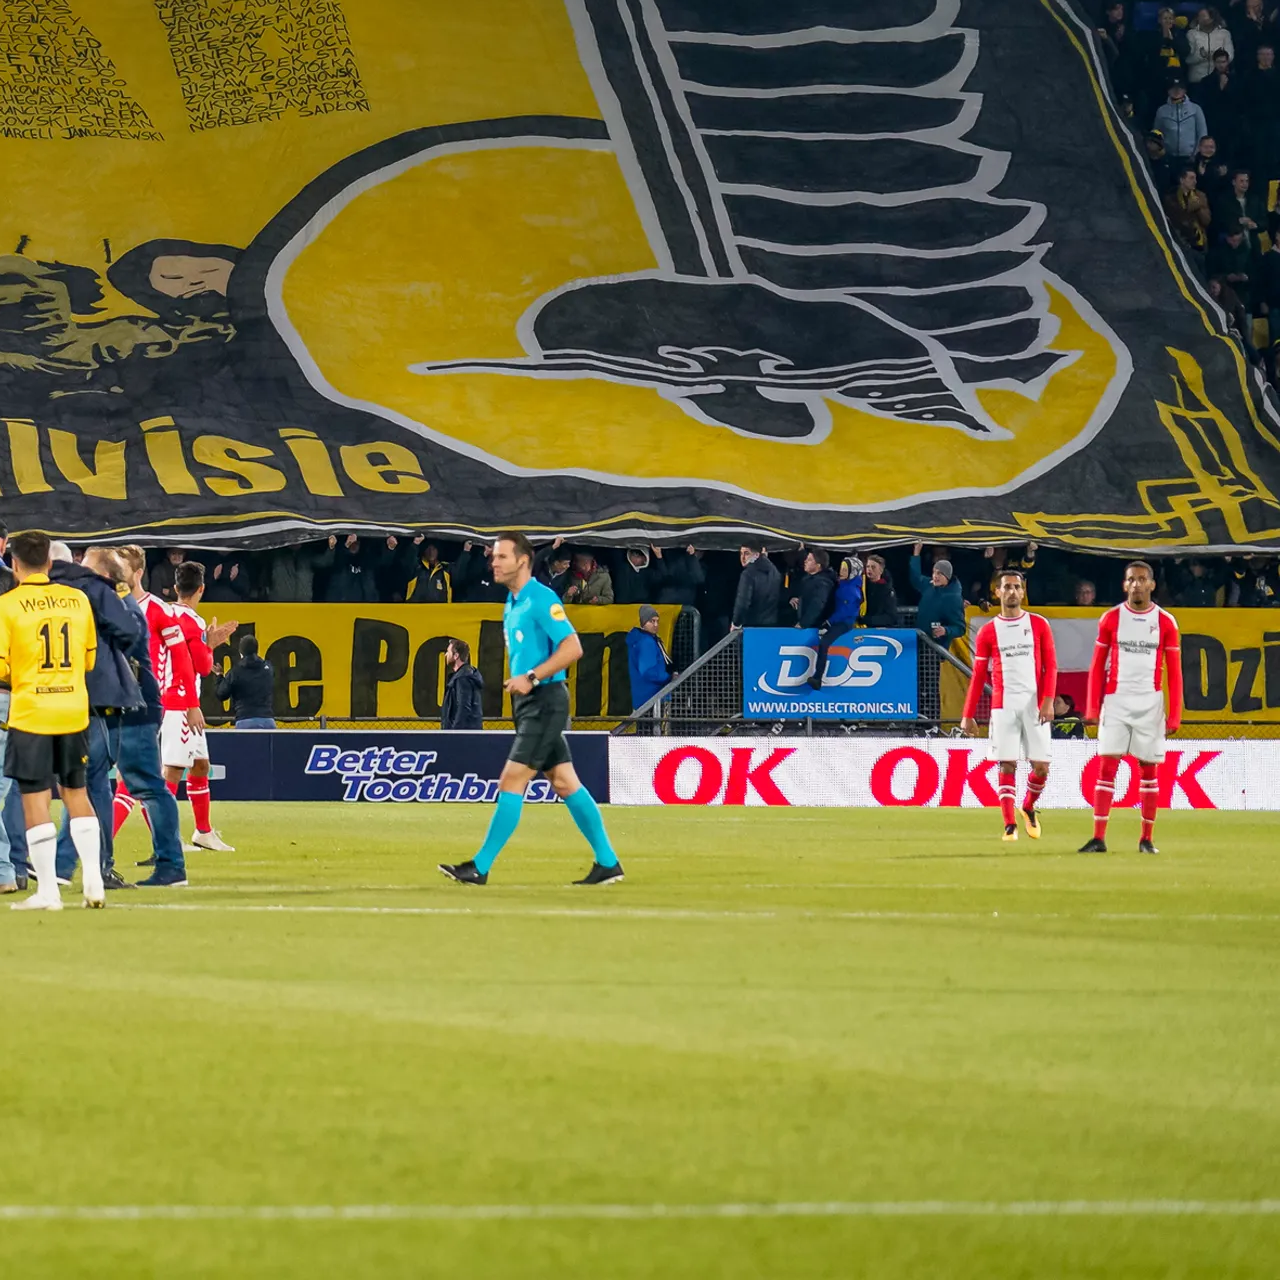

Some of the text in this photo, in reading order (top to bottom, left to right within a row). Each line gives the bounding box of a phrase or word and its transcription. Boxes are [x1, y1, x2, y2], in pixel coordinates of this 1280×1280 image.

[190, 110, 285, 133] NORBERT
[19, 596, 81, 613] Welkom
[38, 620, 72, 670] 11
[777, 645, 889, 687] DDS
[749, 701, 912, 715] WWW.DDSELECTRONICS.NL
[304, 744, 438, 775] Better
[342, 772, 565, 804] Toothbrs
[653, 745, 796, 807] OK
[870, 746, 1012, 807] OK
